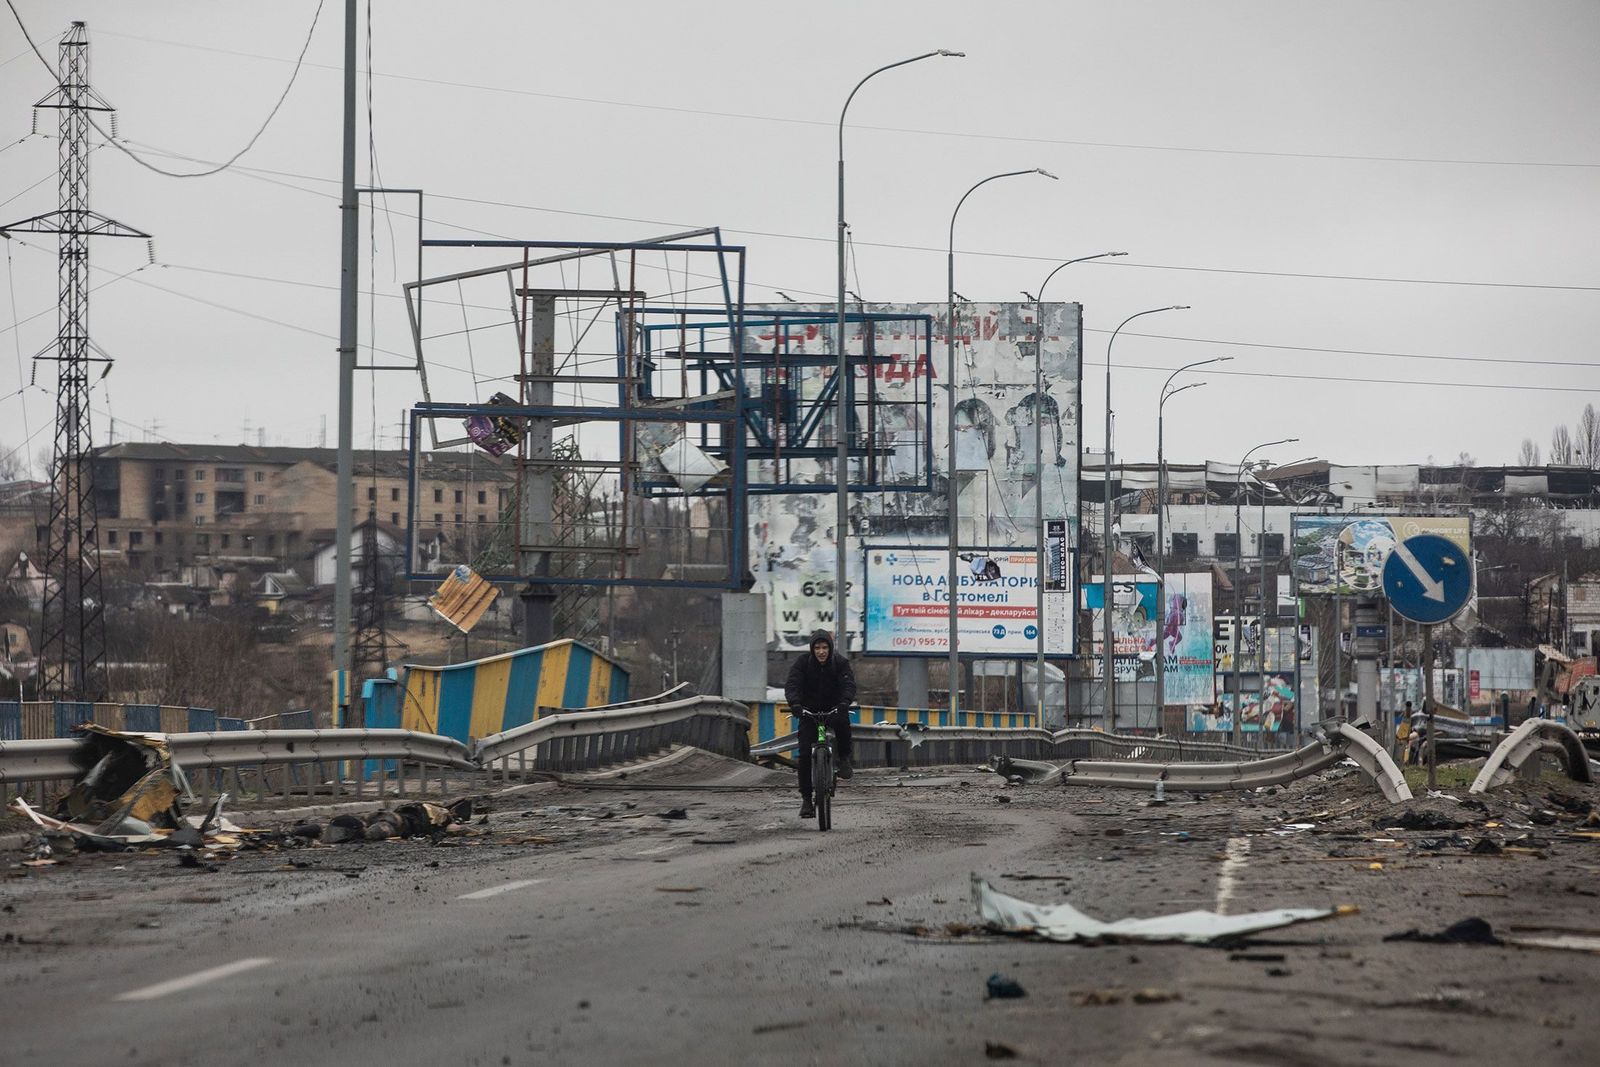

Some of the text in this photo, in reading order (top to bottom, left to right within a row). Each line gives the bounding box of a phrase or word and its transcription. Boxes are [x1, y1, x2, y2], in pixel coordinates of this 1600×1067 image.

[892, 574, 934, 586] НОВА
[934, 589, 1009, 602] Готомелі
[895, 606, 910, 615] Тут
[892, 637, 917, 648] (067)
[919, 638, 936, 647] 955
[937, 638, 949, 647] 72
